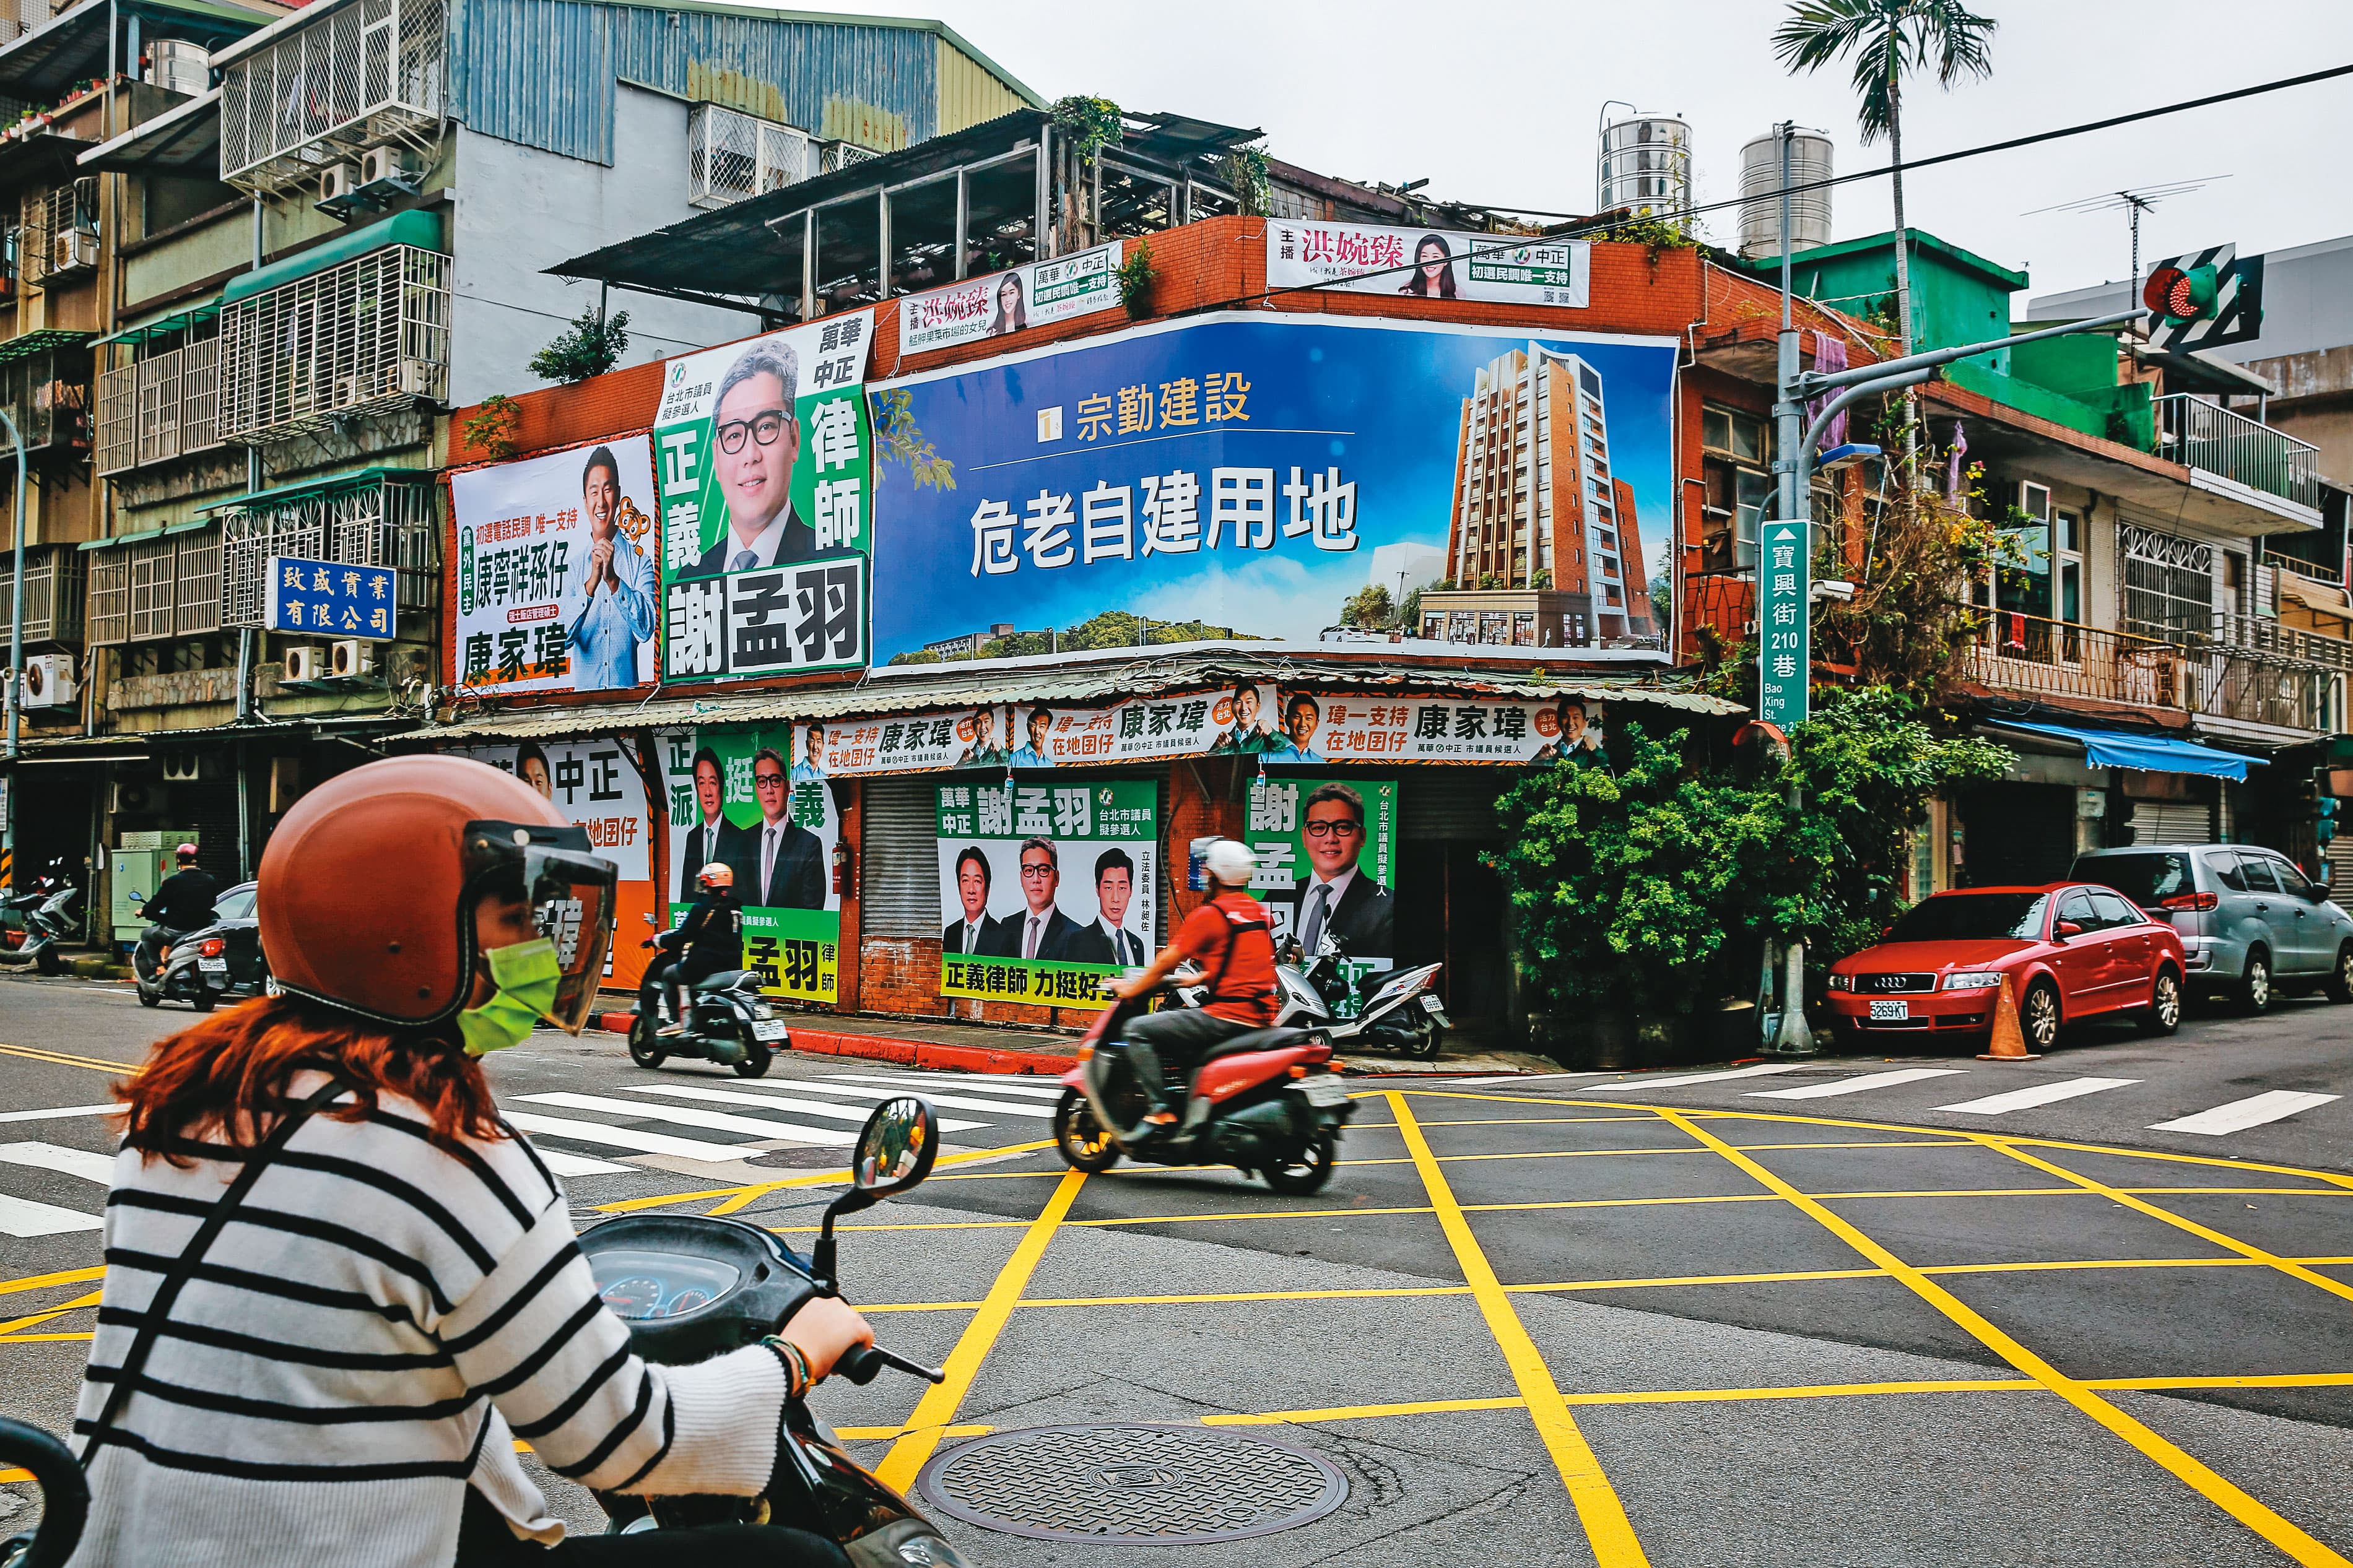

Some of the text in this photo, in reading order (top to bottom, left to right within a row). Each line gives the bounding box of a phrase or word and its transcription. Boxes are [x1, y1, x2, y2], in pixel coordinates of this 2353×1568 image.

[1281, 229, 1294, 260] 主播
[1302, 228, 1404, 268] 洪婉臻
[1475, 245, 1565, 265] 萬華 中正
[1038, 258, 1104, 285] 萬華 中正
[1471, 266, 1568, 285] 初選民調唯一支持
[1035, 275, 1107, 303] 初選民調唯一支持
[910, 303, 919, 330] 主播
[923, 287, 989, 328] 洪婉臻
[819, 317, 863, 353] 萬華
[814, 355, 856, 388] 中正
[666, 382, 713, 405] 台北市議員
[1076, 372, 1252, 442] 宗勤建設
[661, 401, 699, 421] 擬參選人
[811, 397, 861, 551] 律師
[661, 430, 703, 571] 正義
[475, 507, 578, 546] 初選電話民調 唯一支持
[970, 466, 1360, 578] 危老自建用地
[462, 527, 472, 614] 黨外民主
[475, 539, 568, 610] 康寧祥孫仔
[285, 599, 388, 633] 有限公司
[669, 568, 858, 677] 謝孟羽
[1772, 545, 1798, 678] 寶興街210巷
[463, 622, 568, 686] 康家瑋
[1764, 683, 1783, 693] Bao
[1764, 696, 1785, 709] Xing
[1120, 699, 1208, 740] 康家瑋
[1216, 700, 1230, 711] 活力
[1216, 709, 1231, 719] 台北
[1539, 714, 1555, 724] 活力
[1764, 709, 1777, 720] St.
[878, 717, 954, 754] 康家瑋
[959, 719, 972, 730] 活力
[961, 728, 973, 739] 台北
[1414, 704, 1528, 742] 康家瑋
[1541, 722, 1557, 733] 台北
[1053, 734, 1114, 756] 在地囝仔
[1121, 736, 1200, 752] 萬華 中正 市議員候選人
[1326, 730, 1407, 752] 在地囝仔
[1417, 743, 1522, 755] 萬華 中正 市議員候選人
[828, 748, 876, 768] 在地囝仔
[881, 752, 949, 765] 萬華 中正 市議員候選人
[555, 750, 623, 805] 中正
[669, 735, 698, 827] 正派
[724, 756, 754, 803] 挺
[794, 781, 825, 828] 義
[939, 787, 970, 808] 萬華
[976, 787, 1092, 836] 謝孟羽
[942, 813, 972, 835] 中正
[1099, 808, 1152, 821] 台北市議員
[1099, 823, 1141, 836] 擬參選人
[572, 815, 638, 847] 地囝仔
[1376, 800, 1389, 897] 台北市議員擬參選人
[1141, 851, 1150, 932] 立法委員 林昶佐
[743, 935, 819, 992] 孟羽
[821, 943, 836, 992] 律師
[946, 962, 1028, 995] 正義律師
[1871, 1005, 1907, 1017] 5269-KT
